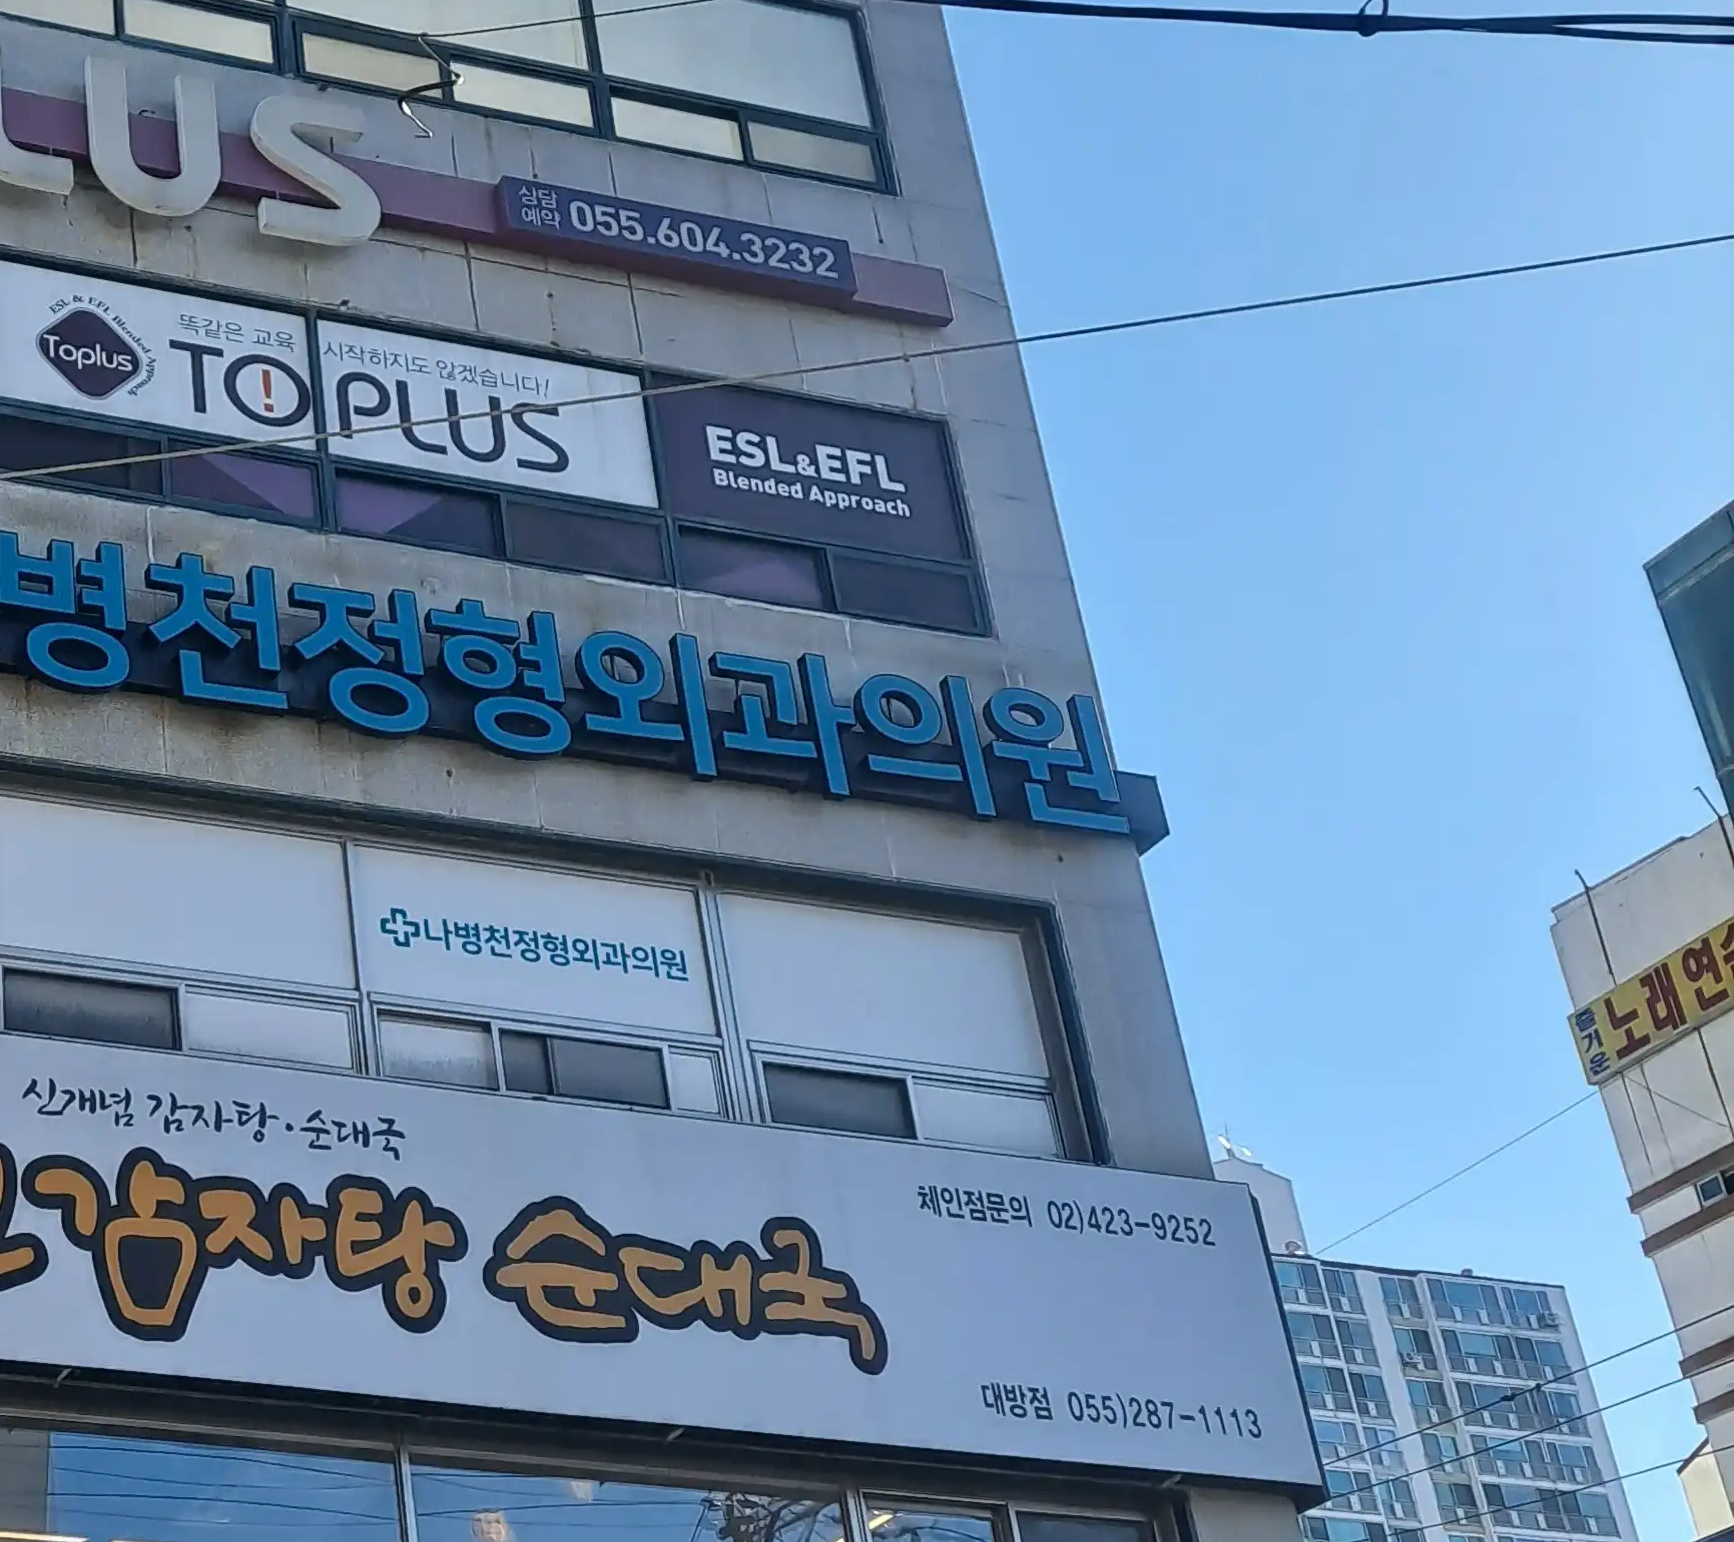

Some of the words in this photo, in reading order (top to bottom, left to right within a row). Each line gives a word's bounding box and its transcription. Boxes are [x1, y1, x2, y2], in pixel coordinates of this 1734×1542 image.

[518, 185, 558, 208] 상담
[520, 204, 561, 232] 예약
[569, 198, 840, 280] 055.604.3232
[43, 334, 133, 372] Toplus
[177, 313, 245, 345] 똑같은
[252, 328, 297, 354] 교육
[322, 339, 432, 376] 시작하지도
[435, 358, 551, 398] 않겠습니다!
[168, 338, 570, 473] TOPLUS
[705, 425, 907, 494] ESL&EFL
[713, 468, 804, 501] Blended
[809, 482, 912, 519] Approach
[423, 918, 690, 982] 나병천정형외과의원
[1575, 1007, 1611, 1077] 즐거운
[22, 1077, 134, 1128] 신개념
[917, 1184, 1033, 1228] 체인점문의
[1047, 1199, 1216, 1247] 02)423-9252
[483, 1195, 888, 1375] 순대국
[980, 1381, 1053, 1421] 대방점
[1067, 1390, 1263, 1440] 055)287-1113
